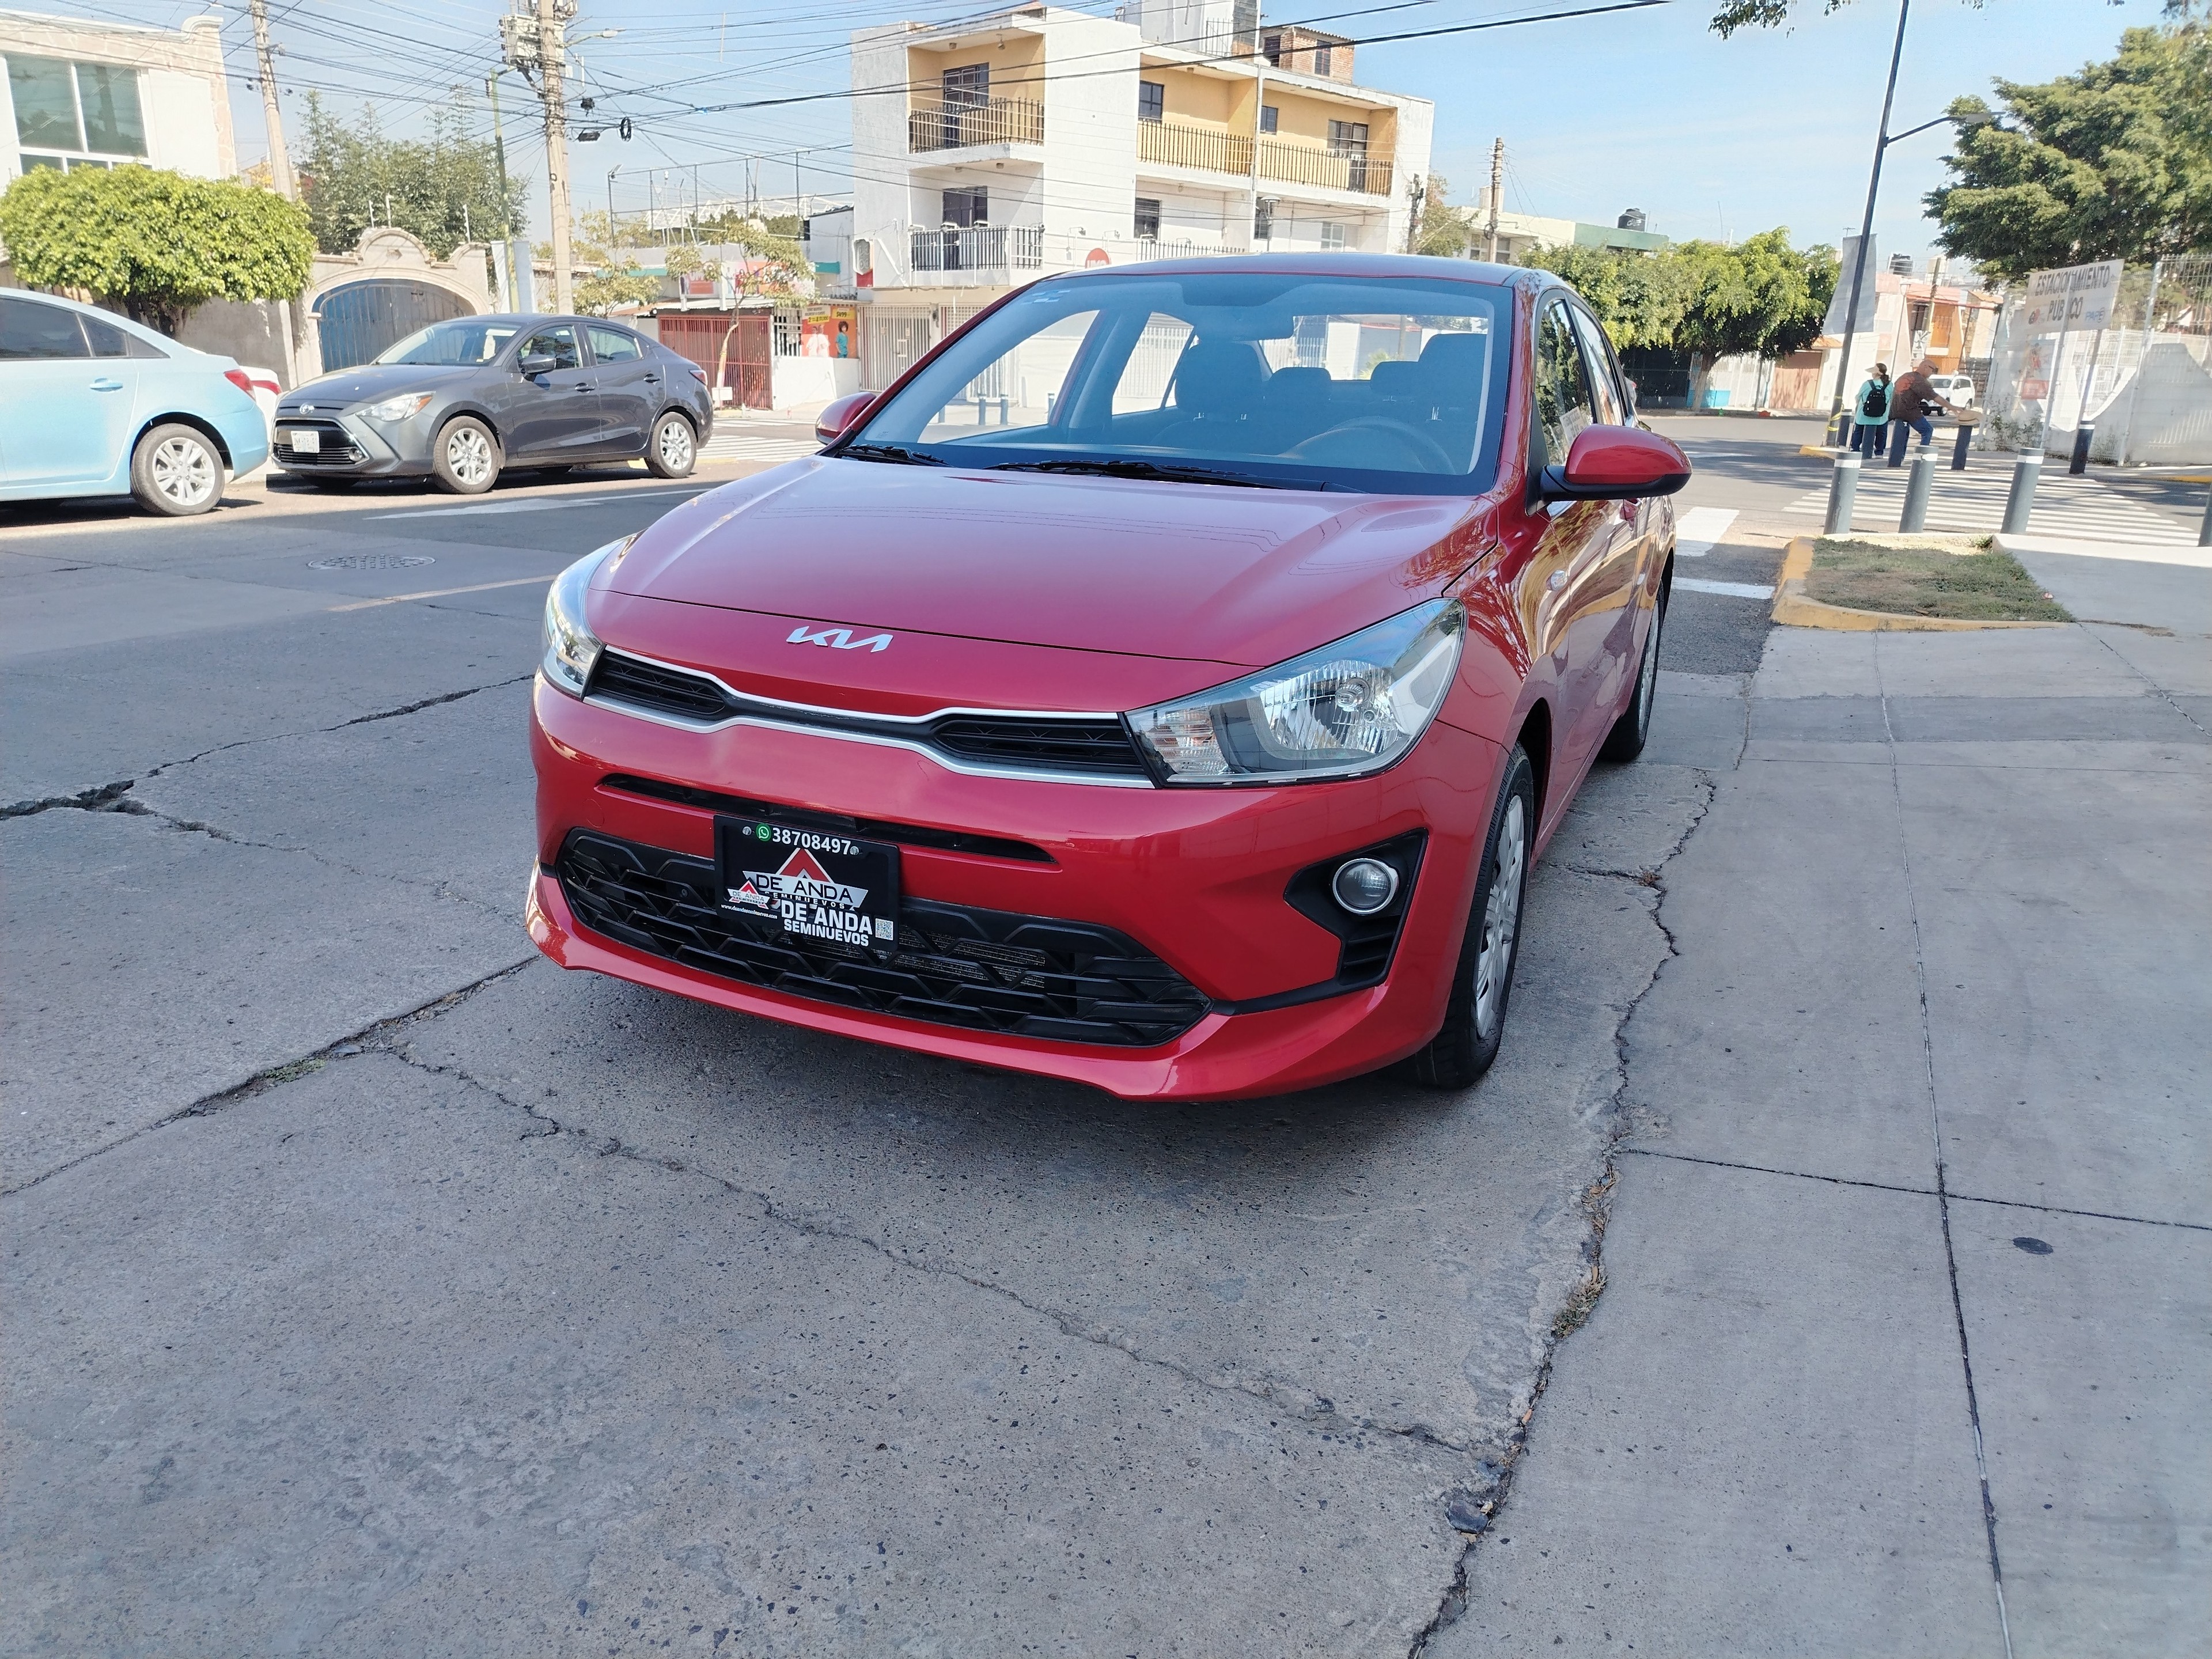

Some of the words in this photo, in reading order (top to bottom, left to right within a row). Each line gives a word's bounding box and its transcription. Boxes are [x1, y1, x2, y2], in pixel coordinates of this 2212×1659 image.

[2047, 294, 2083, 321] PÚBICO
[786, 626, 893, 653] KIA
[772, 827, 851, 854] 38708497
[745, 893, 764, 902] ANDA
[756, 874, 783, 891] DE
[794, 880, 853, 903] ANDA
[781, 899, 807, 922] DE
[814, 907, 873, 935] ANDA
[784, 919, 869, 947] SEMINUEVOS
